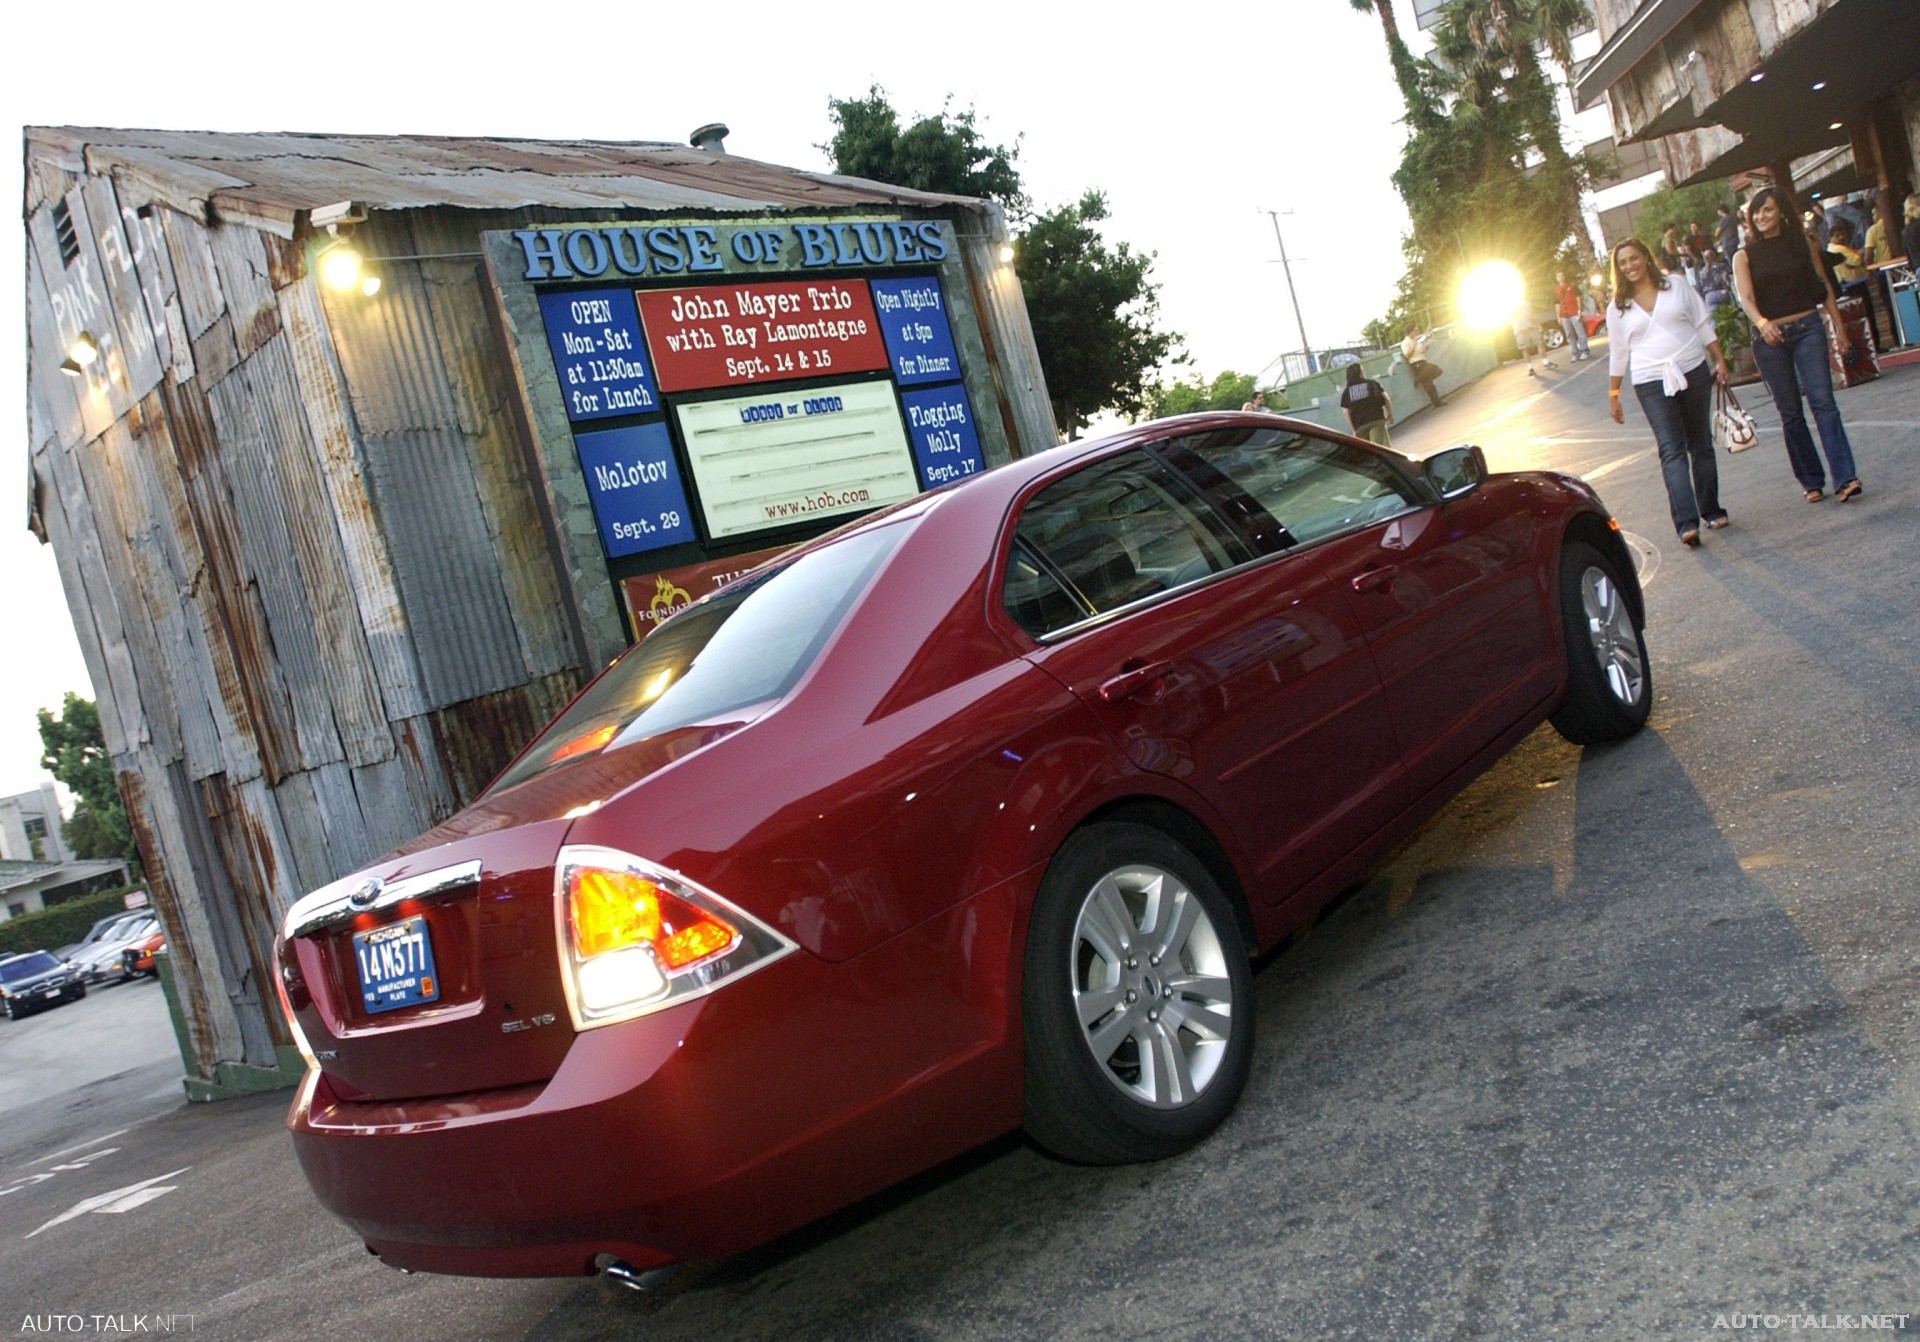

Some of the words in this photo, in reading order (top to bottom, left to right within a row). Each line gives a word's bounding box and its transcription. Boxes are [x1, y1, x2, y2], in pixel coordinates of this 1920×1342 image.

[512, 225, 724, 280] HOUSE
[731, 229, 783, 264] OF
[791, 221, 947, 267] BLUES
[571, 300, 612, 325] OPEN
[671, 294, 730, 322] John
[736, 290, 800, 319] Mayer
[808, 286, 851, 311] Trio
[876, 291, 901, 310] Open
[901, 286, 940, 311] Nightly
[666, 328, 716, 352] with
[721, 324, 757, 348] Ray
[763, 318, 867, 343] Lamontagne
[902, 324, 914, 341] at
[915, 322, 933, 343] 5pm
[567, 367, 586, 385] at
[592, 360, 644, 381] 11:30am
[726, 355, 771, 379] Sept.
[774, 352, 793, 372] 14
[799, 350, 810, 368] &
[815, 349, 832, 367] 15
[899, 355, 918, 375] for
[918, 349, 951, 373] Dinner
[572, 394, 599, 414] for
[603, 384, 652, 411] Lunch
[926, 430, 960, 454] Molly
[594, 459, 668, 492] Molotov
[927, 463, 960, 482] Sept.
[962, 458, 975, 475] 17
[765, 488, 870, 519] www.hob.com
[612, 519, 657, 541] Sept.
[659, 511, 681, 530] 29
[359, 932, 426, 984] 14M377
[501, 1020, 531, 1033] SEL
